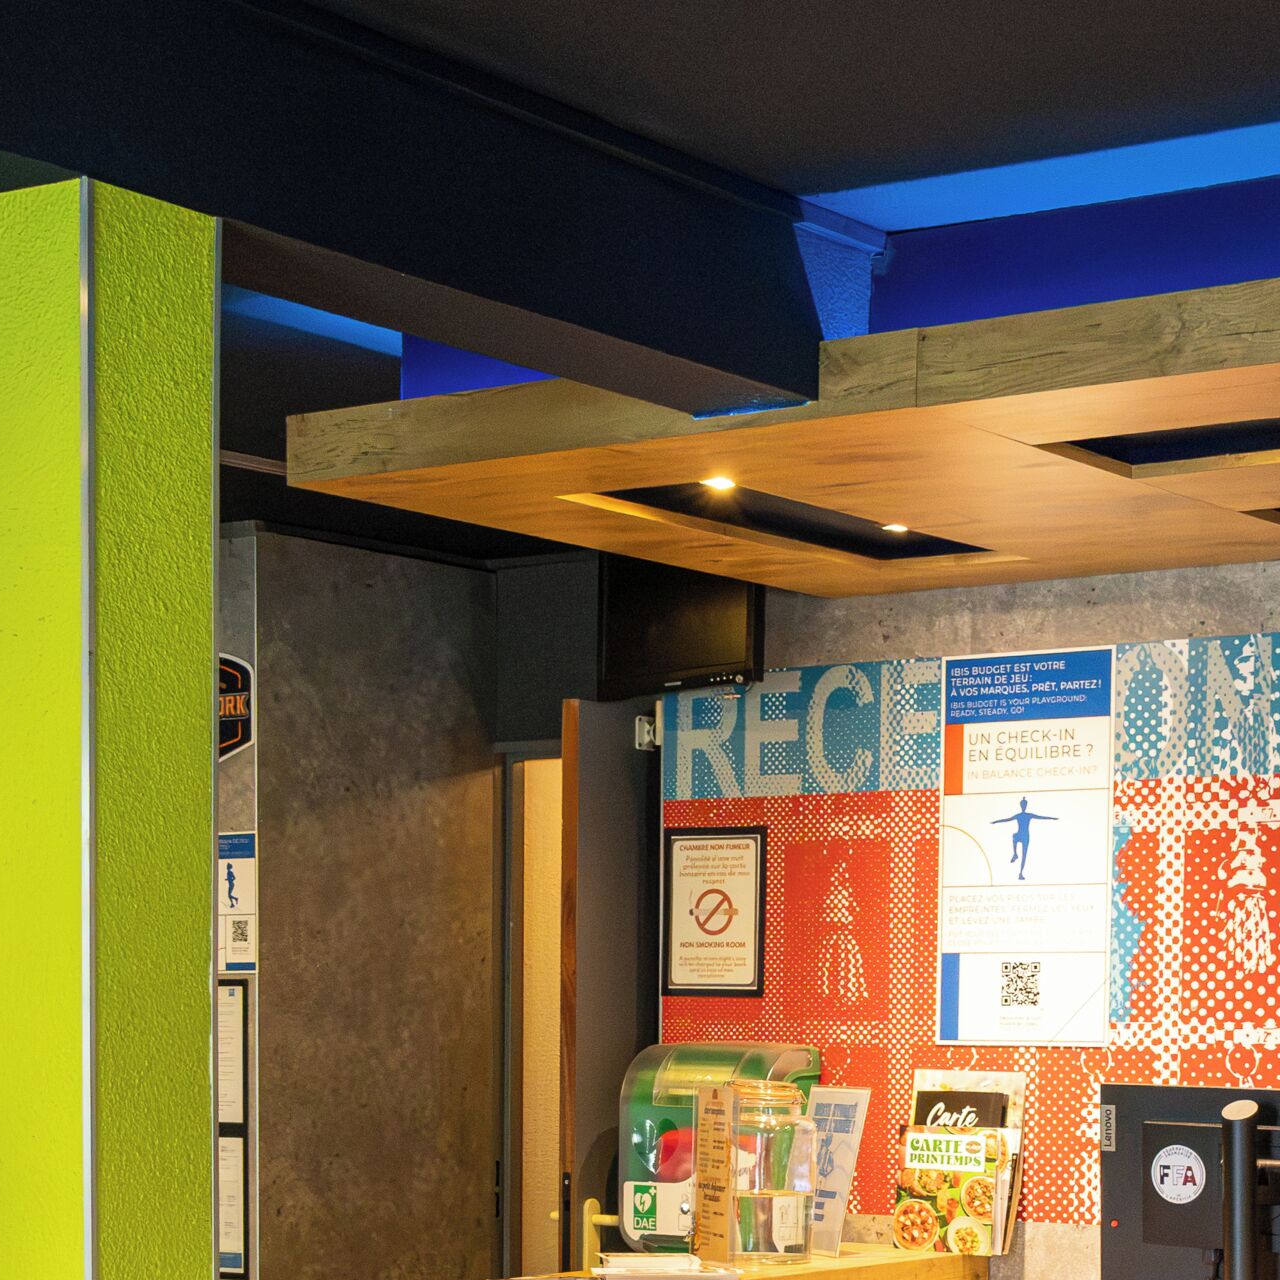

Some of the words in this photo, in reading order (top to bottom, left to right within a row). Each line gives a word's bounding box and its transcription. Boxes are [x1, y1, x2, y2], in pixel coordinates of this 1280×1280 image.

[951, 667, 969, 676] IBIS
[972, 665, 1011, 675] BUDGET
[1014, 663, 1031, 672] EST
[1033, 661, 1065, 671] VOTRE
[951, 676, 991, 686] TERRAIN
[994, 675, 1007, 684] DE
[959, 687, 978, 696] VOS
[967, 700, 998, 708] BUDGET
[1009, 697, 1029, 705] YOUR
[969, 733, 991, 745] UN
[996, 729, 1075, 744] CHECK-IN
[969, 749, 988, 761] EN
[982, 768, 1033, 779] BALANCE
[926, 1102, 979, 1127] Carte
[1103, 1109, 1112, 1148] Lenovo
[910, 1138, 962, 1154] CARTE
[909, 1153, 982, 1167] PRINTEMPS
[1160, 1164, 1197, 1187] FFA
[634, 1218, 656, 1230] DAE
